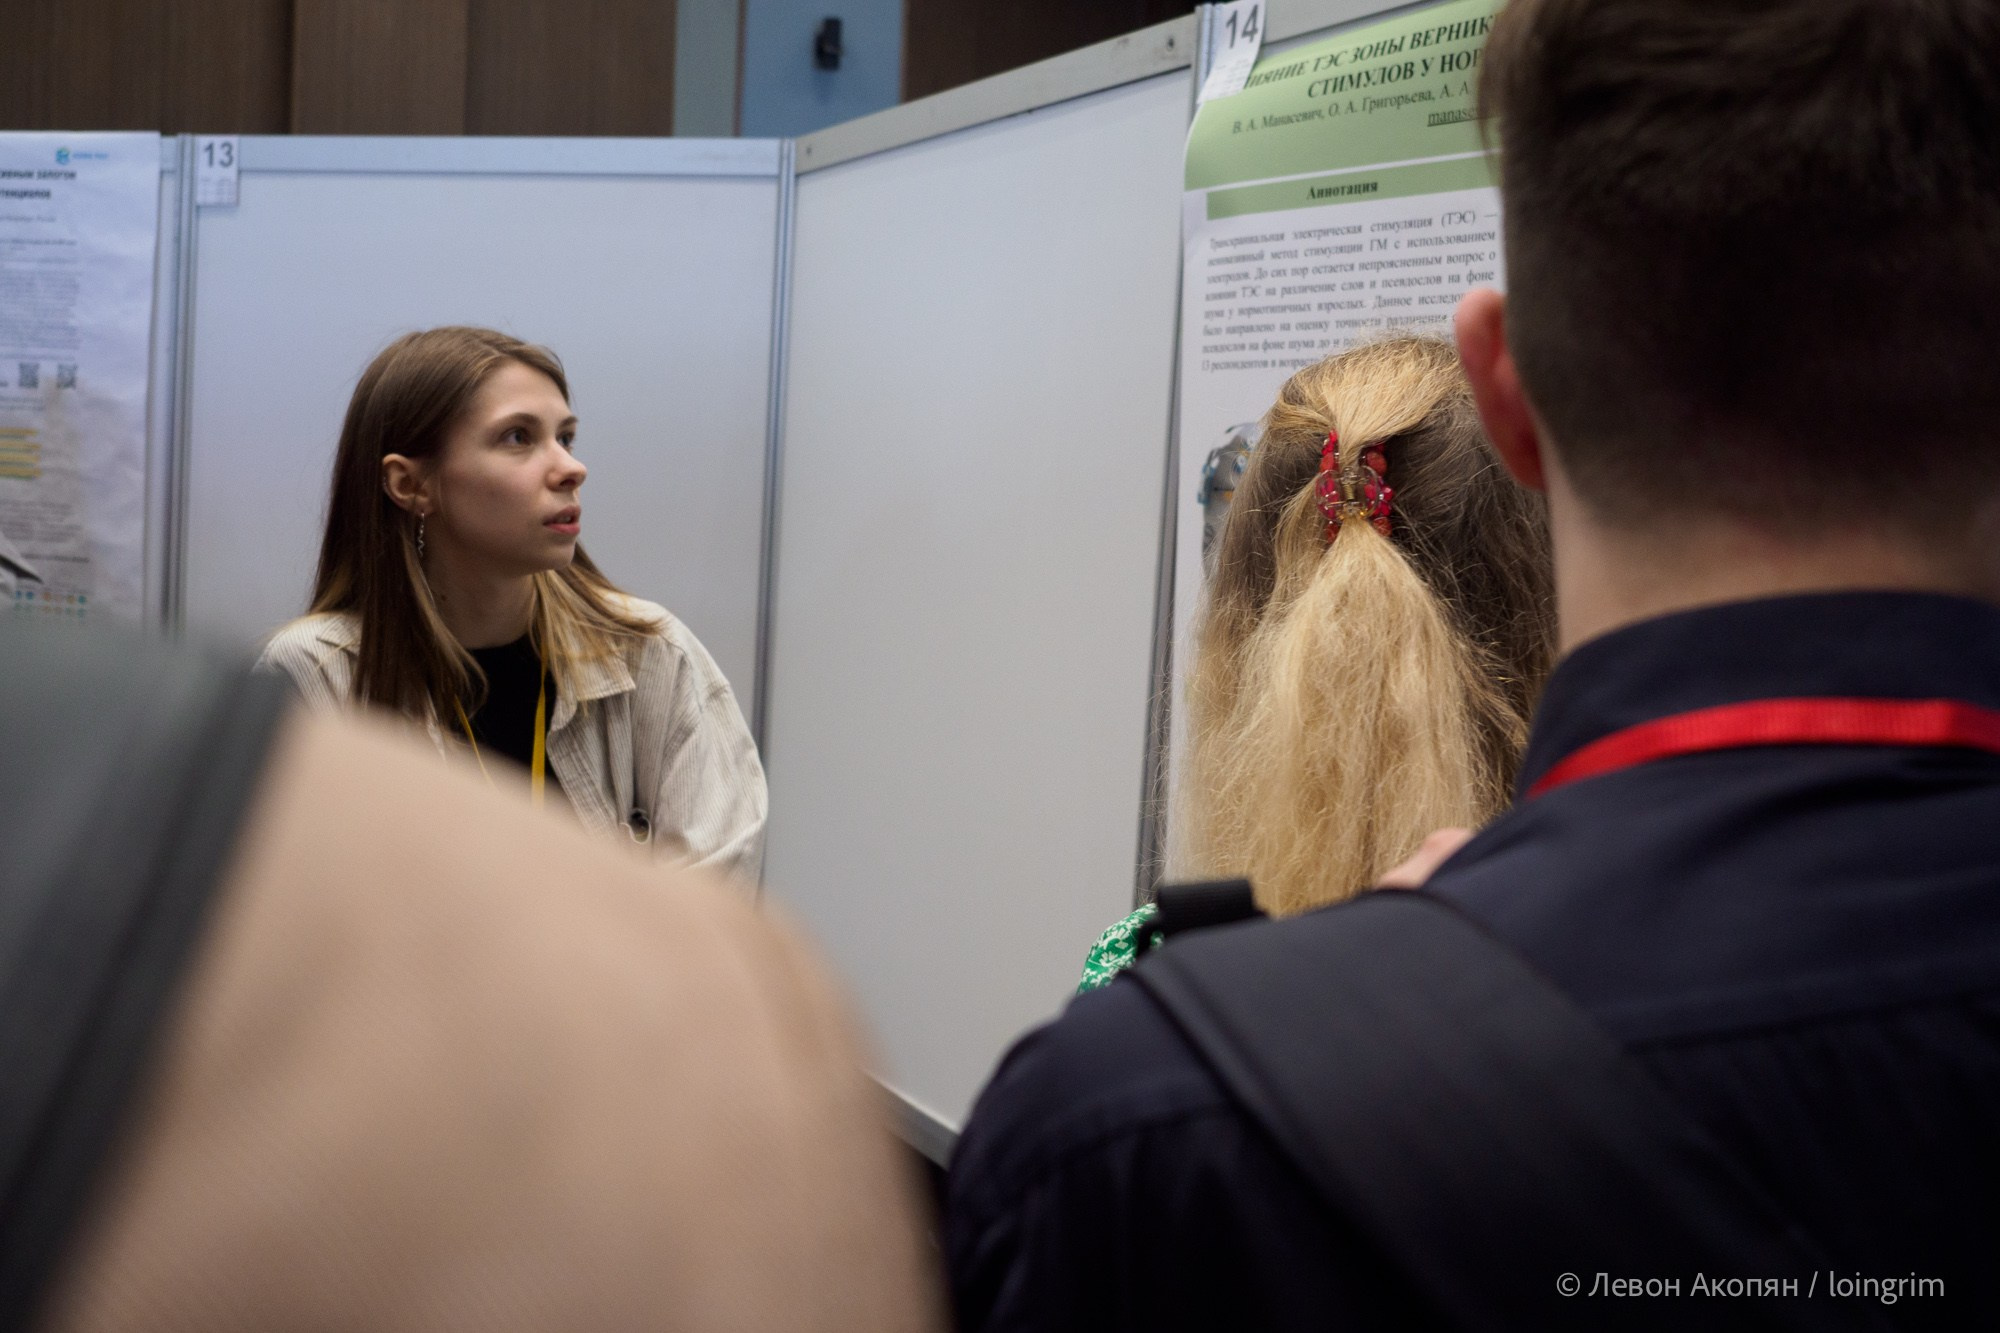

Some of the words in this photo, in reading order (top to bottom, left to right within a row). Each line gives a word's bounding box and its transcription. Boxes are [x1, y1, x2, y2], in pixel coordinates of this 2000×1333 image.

[1226, 4, 1259, 48] 14
[1313, 50, 1348, 72] ТЭС
[1349, 35, 1406, 63] ЗОНЫ
[1409, 14, 1493, 50] ВЕРНИК
[1307, 61, 1414, 98] СТИМУЛОВ
[1420, 57, 1434, 77] У
[1362, 90, 1436, 114] Григорьева,
[204, 141, 234, 168] 13
[1307, 182, 1378, 200] Аннотация
[1370, 218, 1433, 233] стимуляция
[1441, 210, 1476, 227] (ТЭС)
[1270, 249, 1298, 260] метод
[1304, 243, 1363, 258] стимуляции
[1370, 238, 1387, 251] ГМ
[1394, 241, 1400, 249] с
[1407, 231, 1495, 249] использованием
[1255, 267, 1268, 281] До
[1270, 268, 1287, 278] сих
[1291, 266, 1308, 279] пор
[1311, 263, 1354, 275] остается
[1358, 257, 1442, 273] непроясненным
[1446, 251, 1485, 266] вопрос
[1489, 251, 1496, 260] о
[1241, 286, 1261, 297] ТЭС
[1280, 282, 1337, 298] различение
[1341, 280, 1364, 292] слов
[1369, 280, 1376, 289] и
[1381, 275, 1442, 289] псевдослов
[1448, 274, 1460, 284] на
[1466, 269, 1495, 285] фоне
[1317, 300, 1366, 314] взрослых.
[1373, 295, 1412, 309] Данное
[1295, 320, 1329, 332] оценку
